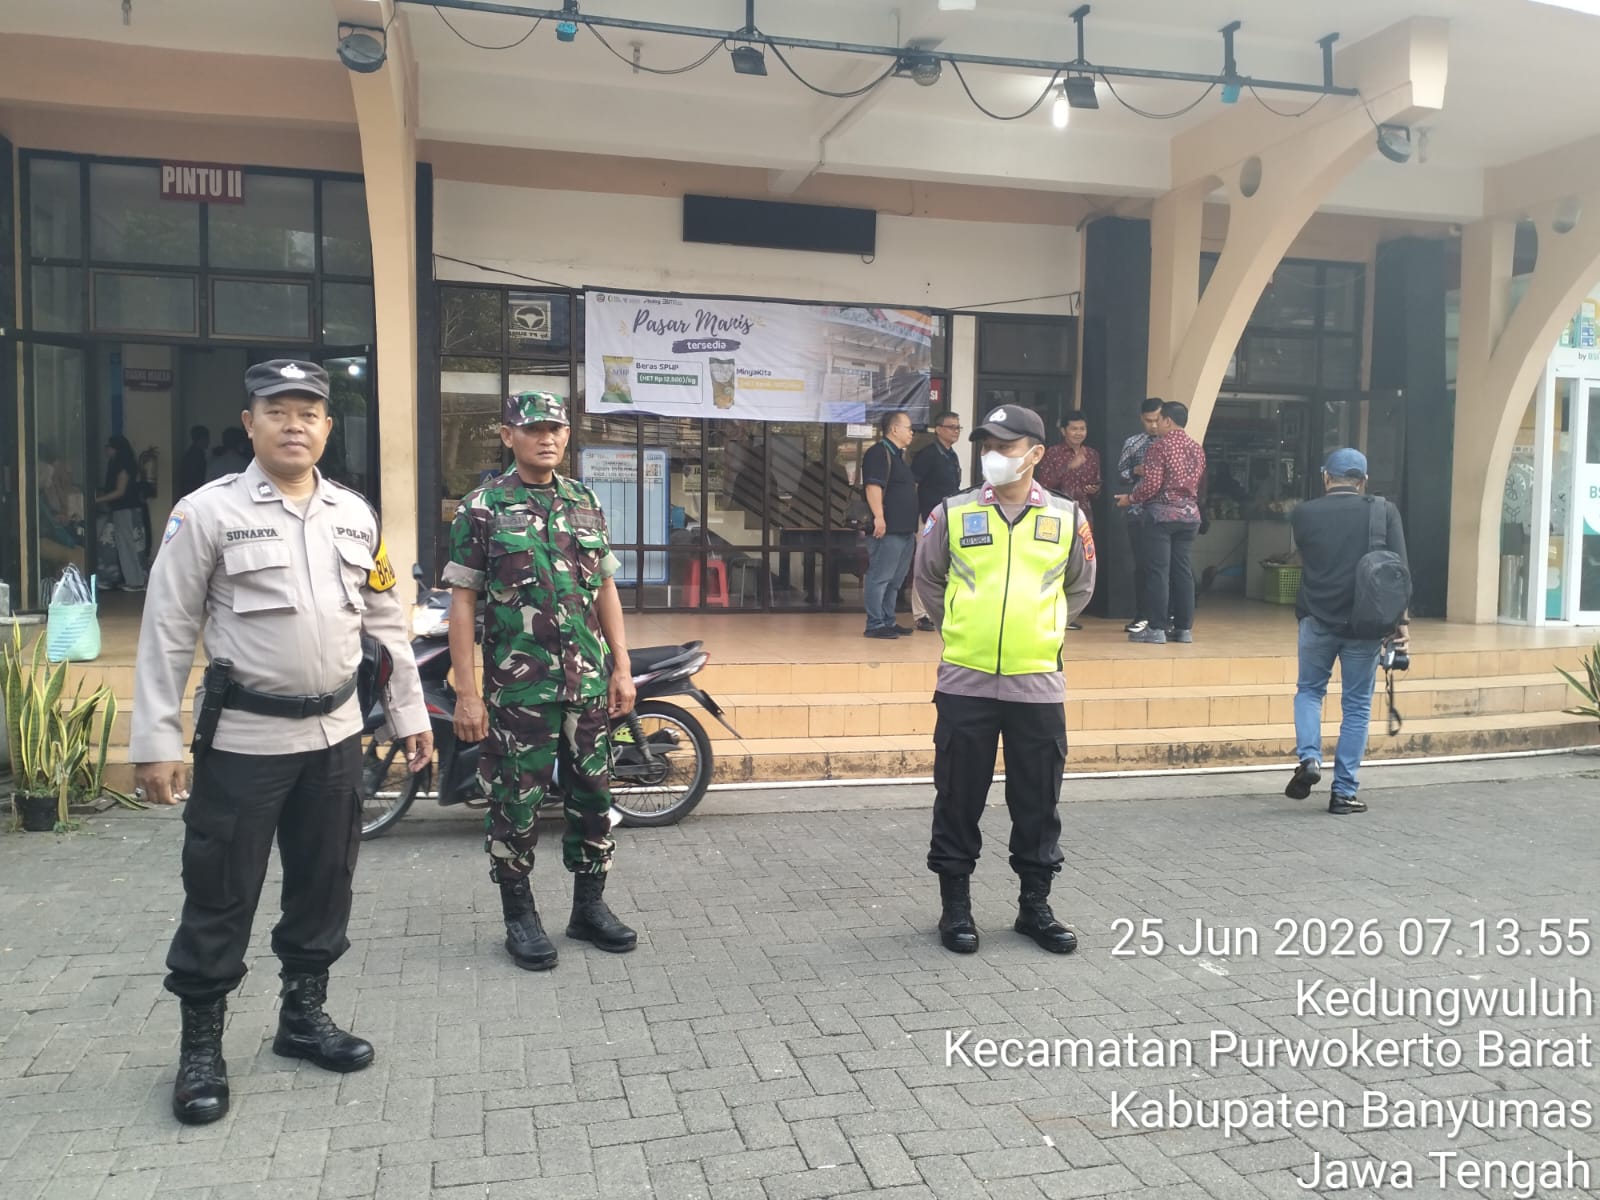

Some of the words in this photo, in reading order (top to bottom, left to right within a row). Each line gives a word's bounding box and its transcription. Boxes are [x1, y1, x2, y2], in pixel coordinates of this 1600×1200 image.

[162, 166, 222, 196] PINTU
[228, 170, 241, 197] II
[633, 309, 690, 335] Pasar
[695, 309, 754, 337] Manis
[687, 341, 726, 350] tersedia
[1578, 352, 1587, 361] by
[635, 362, 658, 370] Beras
[226, 528, 279, 542] SUNARYA
[335, 526, 371, 543] POLRI
